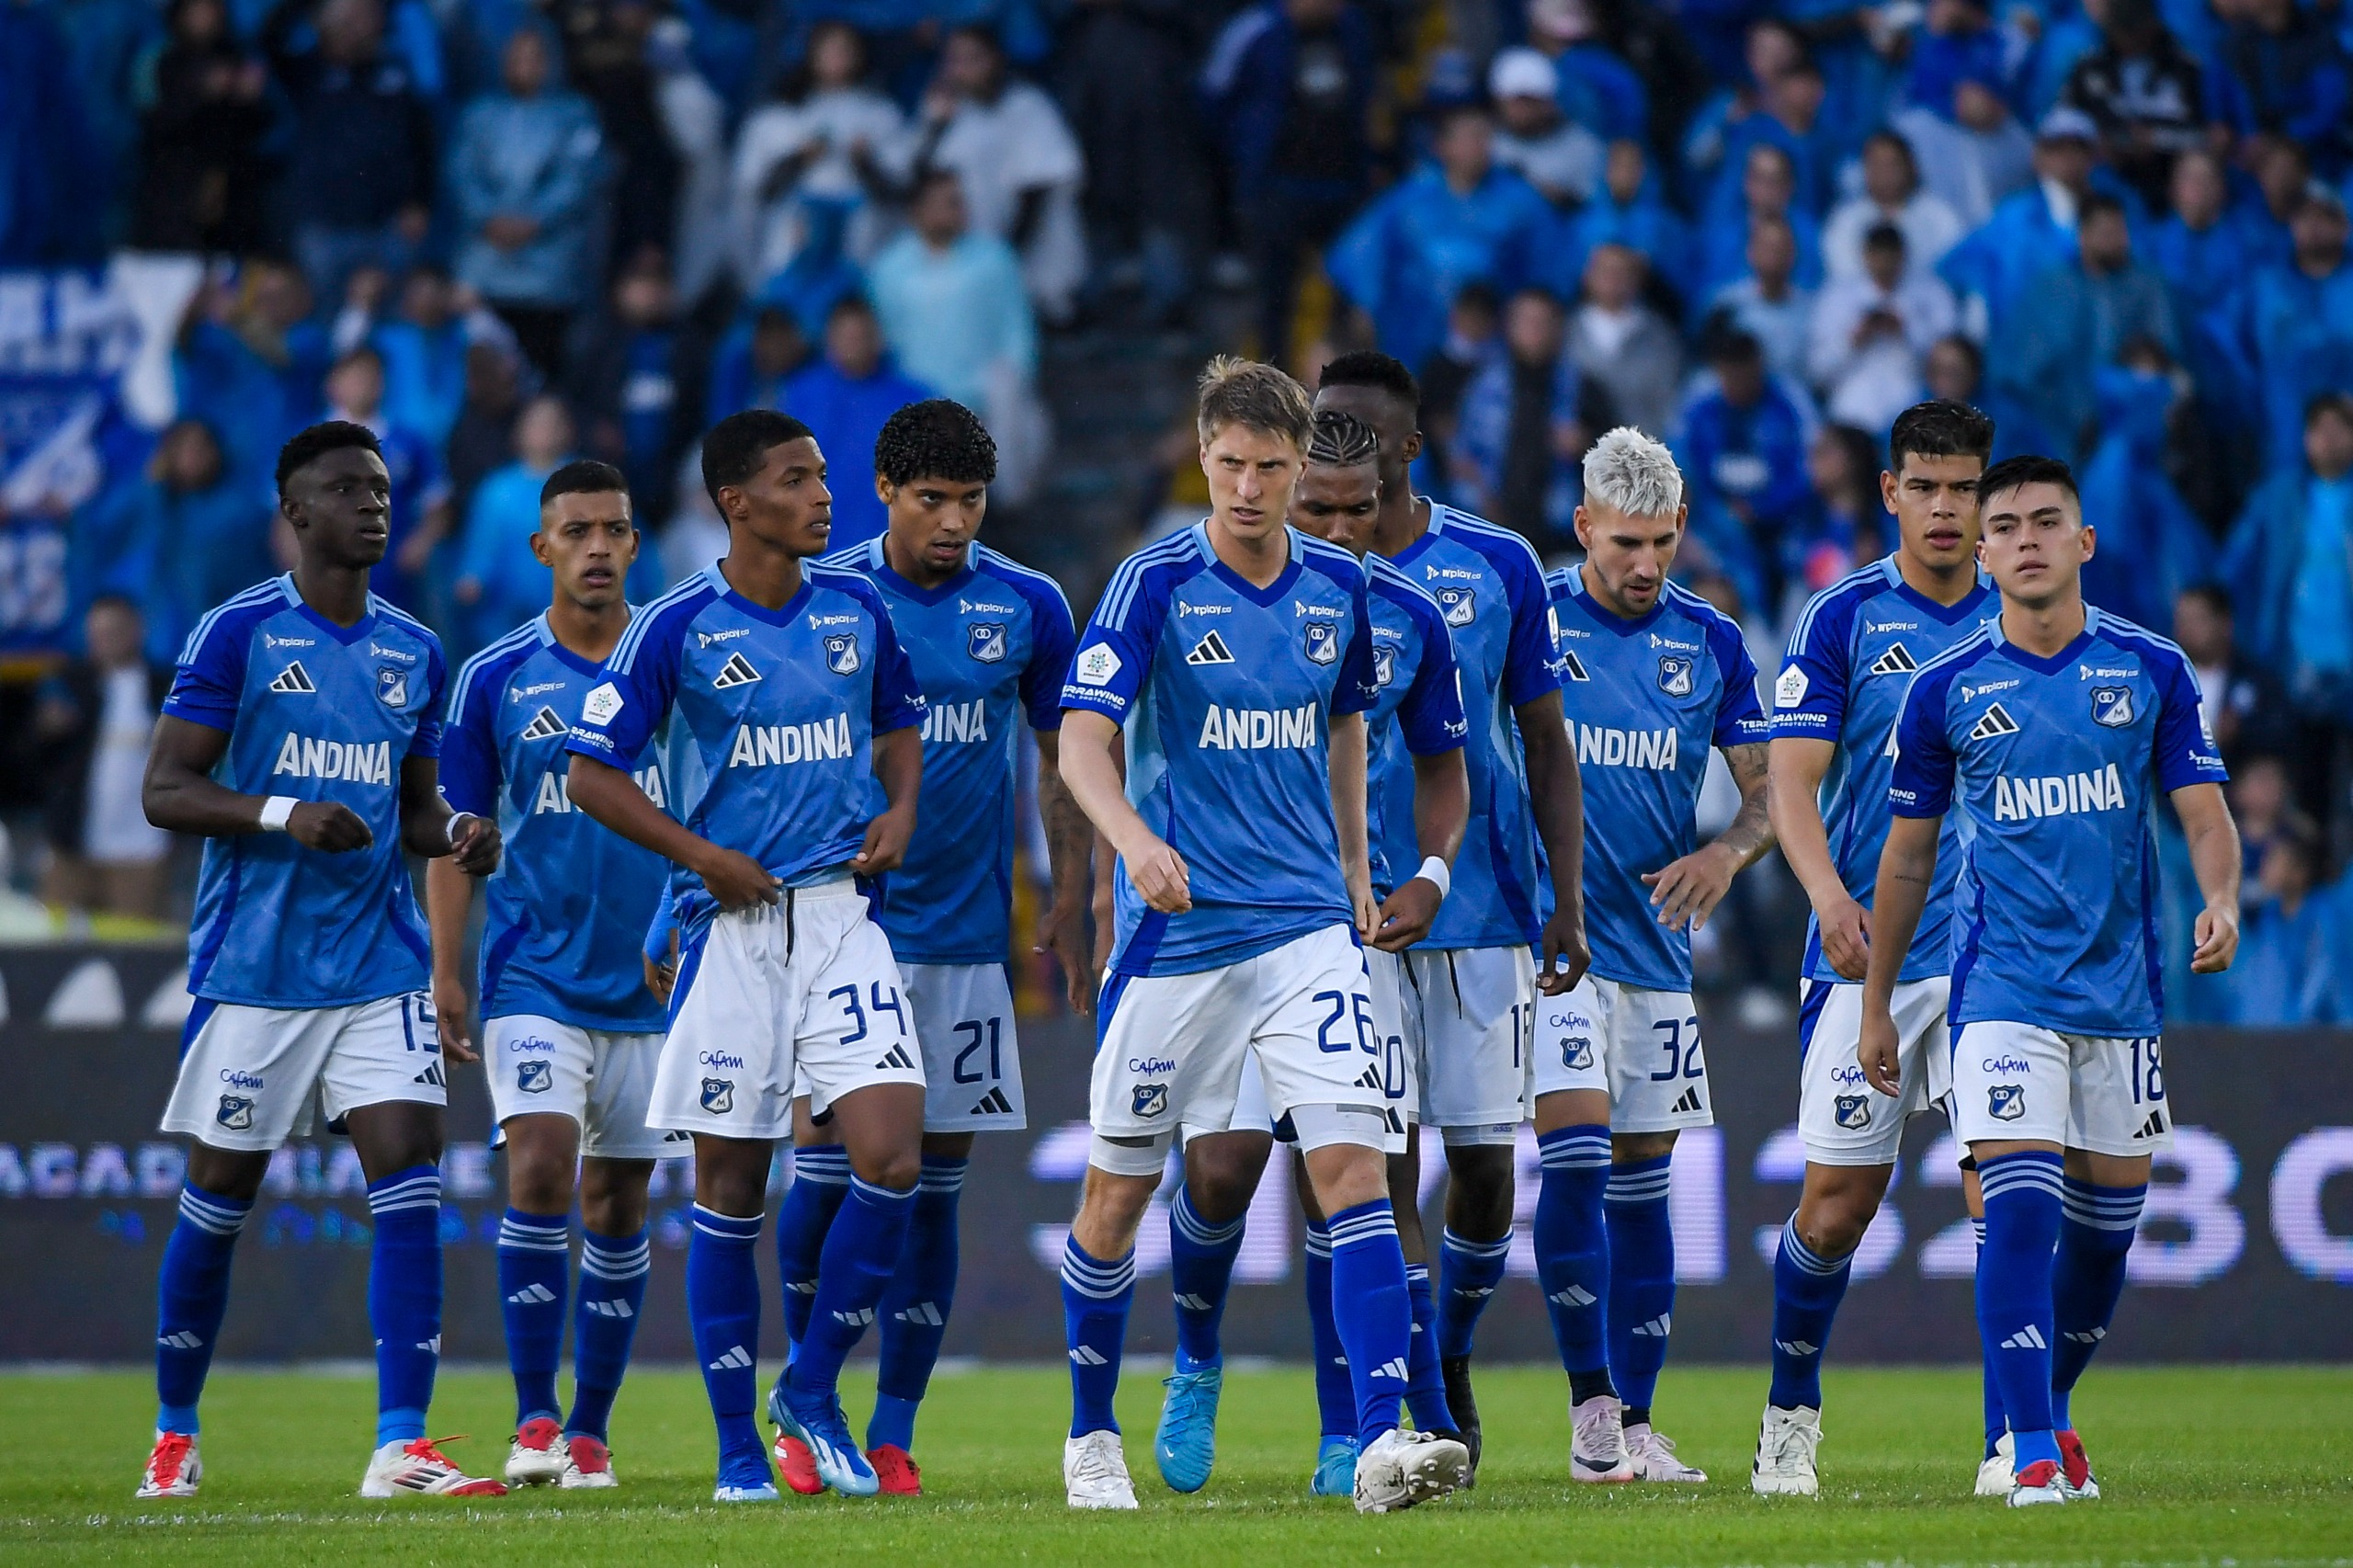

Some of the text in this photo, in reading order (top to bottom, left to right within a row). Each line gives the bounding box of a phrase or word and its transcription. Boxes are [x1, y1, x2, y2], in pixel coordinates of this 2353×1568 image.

[729, 711, 853, 768] ANDINA
[1198, 701, 1317, 751] ANDINA
[273, 733, 392, 786] ANDINA
[1995, 763, 2126, 822] ANDINA
[398, 993, 441, 1054] 15
[828, 980, 907, 1046] 34
[1312, 990, 1378, 1057] 26
[953, 1017, 1002, 1085] 21
[1376, 1035, 1406, 1099] 0
[1651, 1016, 1704, 1082] 32
[2131, 1037, 2165, 1105] 18
